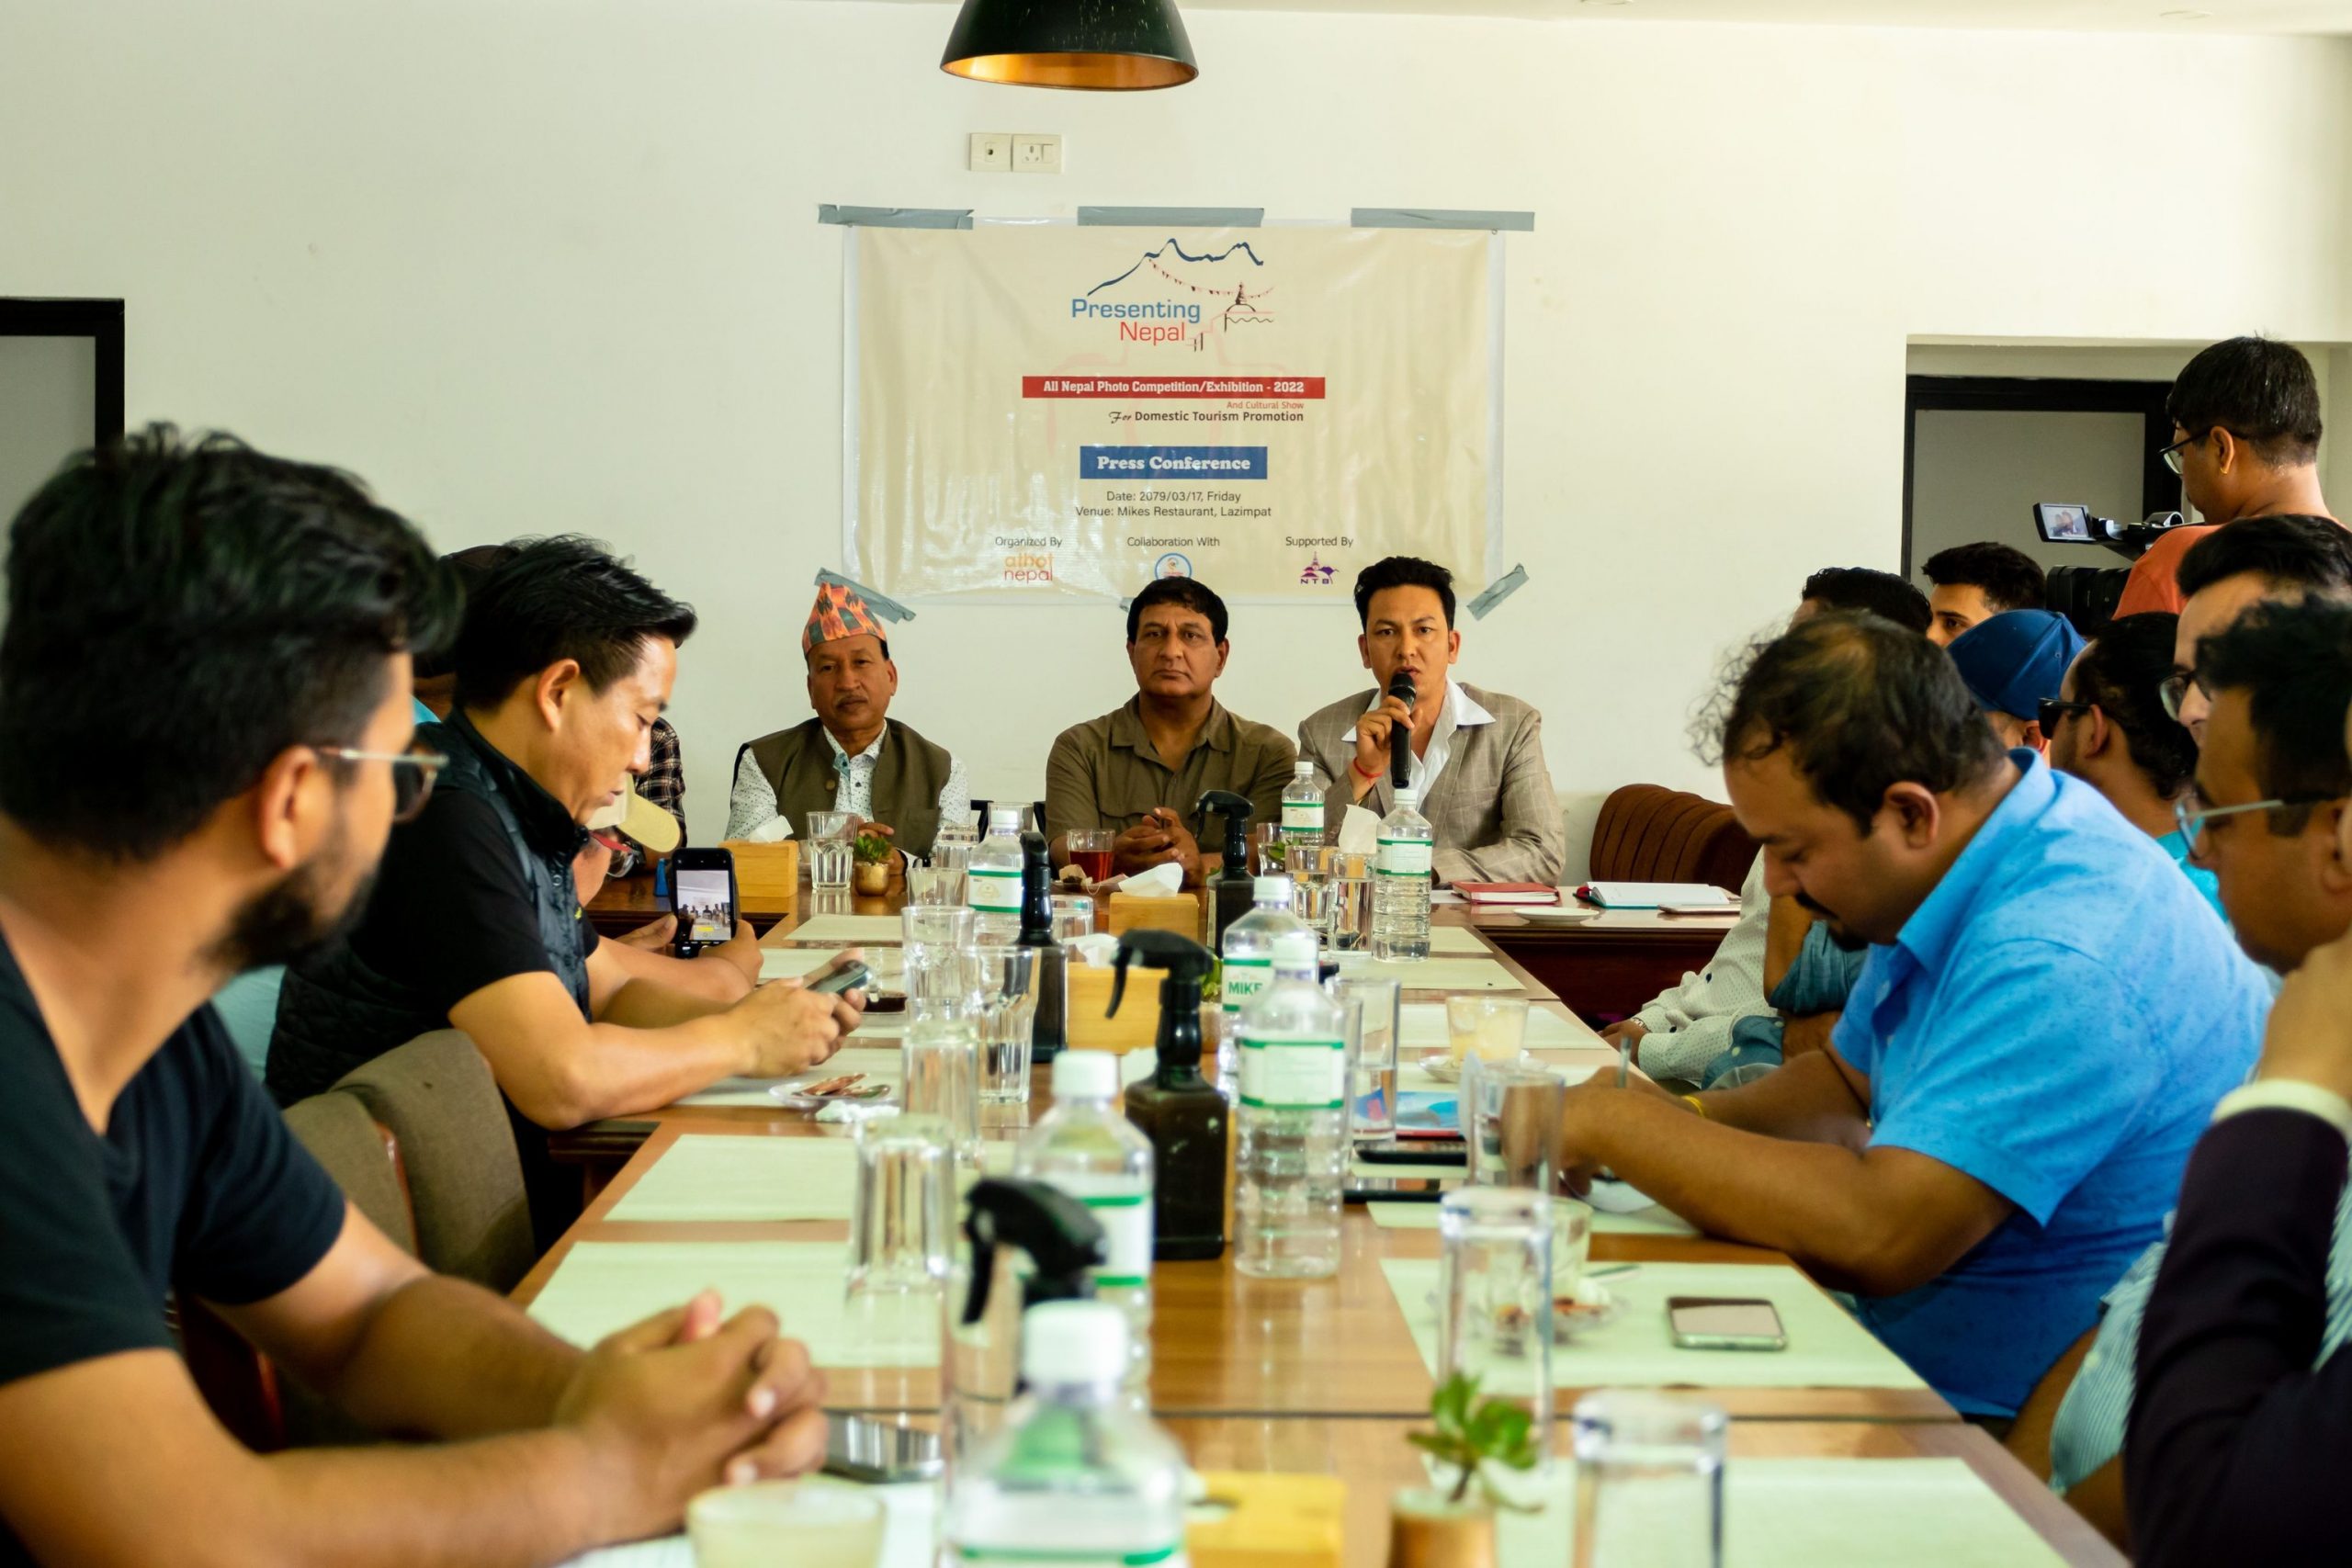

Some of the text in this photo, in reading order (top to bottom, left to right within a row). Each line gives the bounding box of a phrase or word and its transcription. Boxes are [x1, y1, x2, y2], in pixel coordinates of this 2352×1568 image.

[1071, 299, 1201, 324] Presenting
[1120, 321, 1185, 346] Nepal
[1043, 380, 1059, 392] All
[1061, 380, 1094, 394] Nepal
[1097, 380, 1129, 392] Photo
[1132, 380, 1263, 395] Competition/Exhibition
[1273, 381, 1305, 393] 2022
[1227, 401, 1305, 410] And Cultural Show
[1108, 411, 1304, 424] For Domestic Tourism Promotion
[1097, 456, 1251, 471] Press Conference
[1106, 491, 1241, 504] Date: 2079/03/17, Friday
[1076, 506, 1272, 519] Venue: Mikes Restaurant, Lazimpat
[995, 536, 1063, 548] Organized By
[1126, 536, 1220, 547] Collaboration With
[1285, 536, 1354, 548] Supported By
[1004, 567, 1053, 585] nepal
